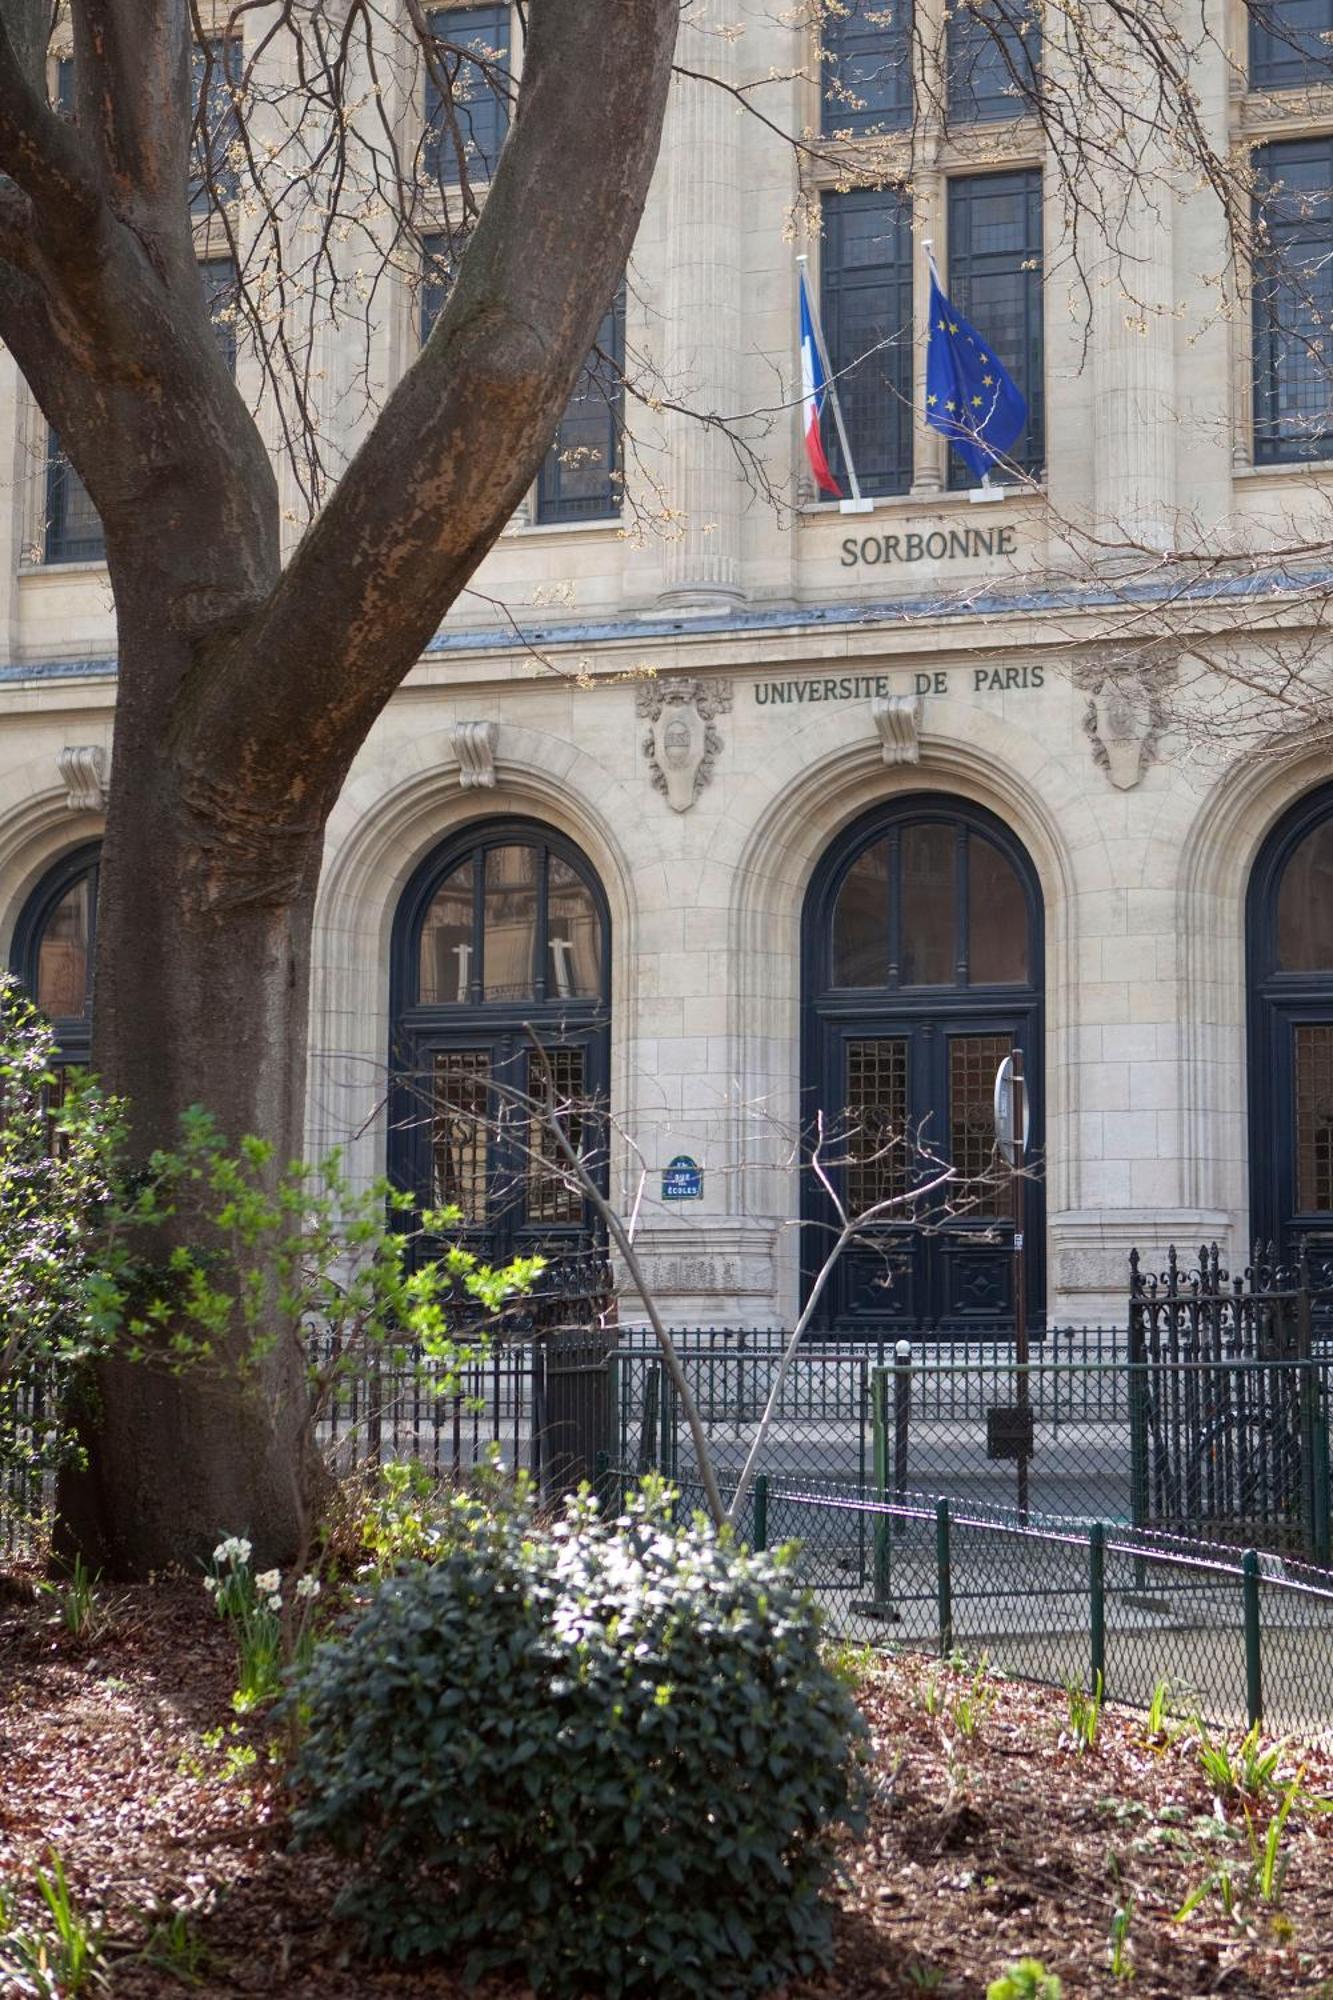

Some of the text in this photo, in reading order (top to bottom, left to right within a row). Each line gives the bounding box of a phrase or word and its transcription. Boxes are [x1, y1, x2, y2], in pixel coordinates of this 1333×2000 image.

[841, 526, 1018, 567] SORBONNE
[754, 666, 1045, 705] UNIVERSITE DE PARIS
